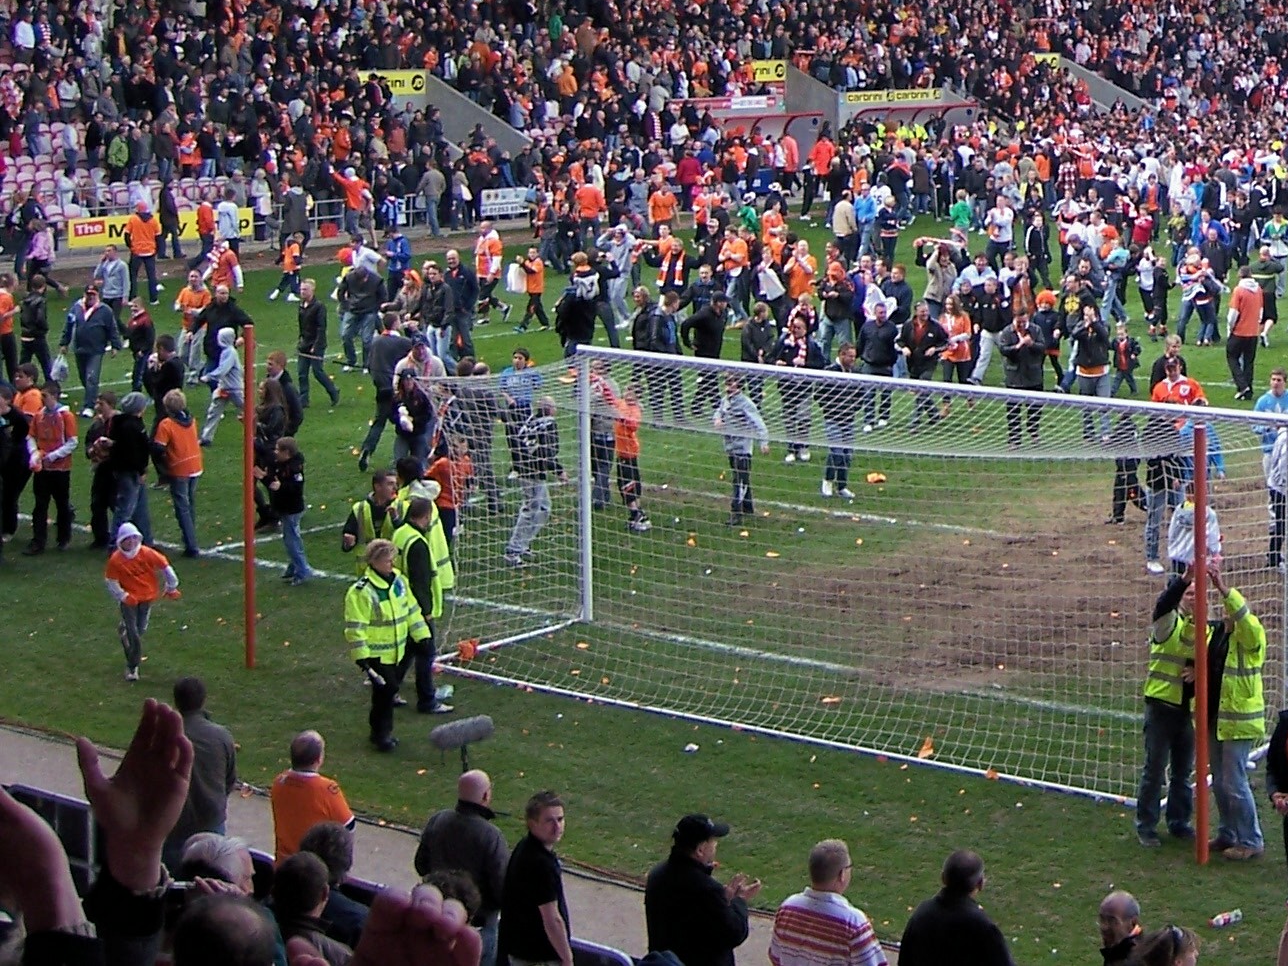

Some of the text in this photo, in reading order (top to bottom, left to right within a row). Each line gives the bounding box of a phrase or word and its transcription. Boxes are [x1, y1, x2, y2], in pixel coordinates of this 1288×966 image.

[847, 91, 929, 102] carbrini carbrini
[75, 222, 103, 235] The
